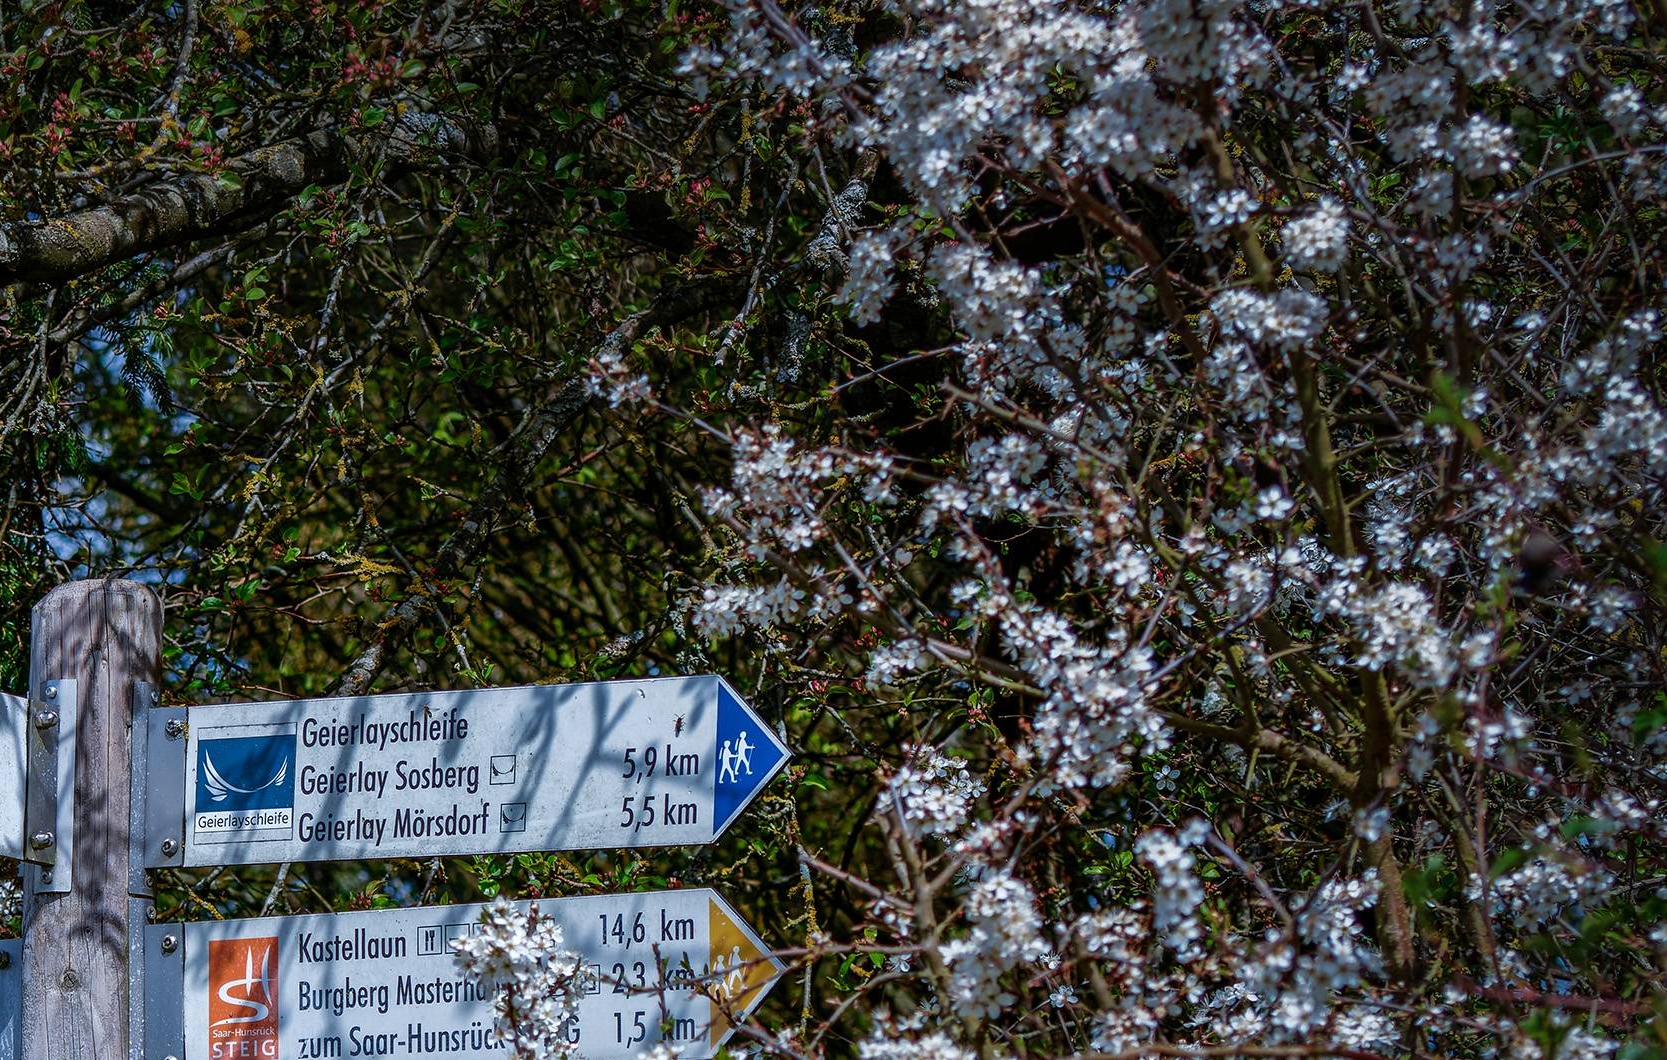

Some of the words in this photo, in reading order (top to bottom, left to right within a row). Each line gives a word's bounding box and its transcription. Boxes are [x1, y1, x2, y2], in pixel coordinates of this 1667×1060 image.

[302, 707, 469, 751] Geierlayschleife
[300, 761, 389, 799] Geierlay
[395, 757, 480, 794] Sosberg
[622, 746, 658, 784] 5,9
[665, 744, 699, 776] km
[197, 812, 290, 830] Geierlayschleife
[298, 809, 386, 847] Geierlay
[393, 802, 490, 839] Mörsdorf
[620, 796, 655, 833] 5,5
[663, 793, 698, 826] km
[298, 928, 407, 964] Kastellaun
[599, 912, 646, 950] 14,6
[661, 909, 695, 941] km
[298, 976, 390, 1017] Burgberg
[212, 1039, 276, 1059] STEIG
[298, 1037, 342, 1060] zum
[613, 1011, 646, 1049] 1,5
